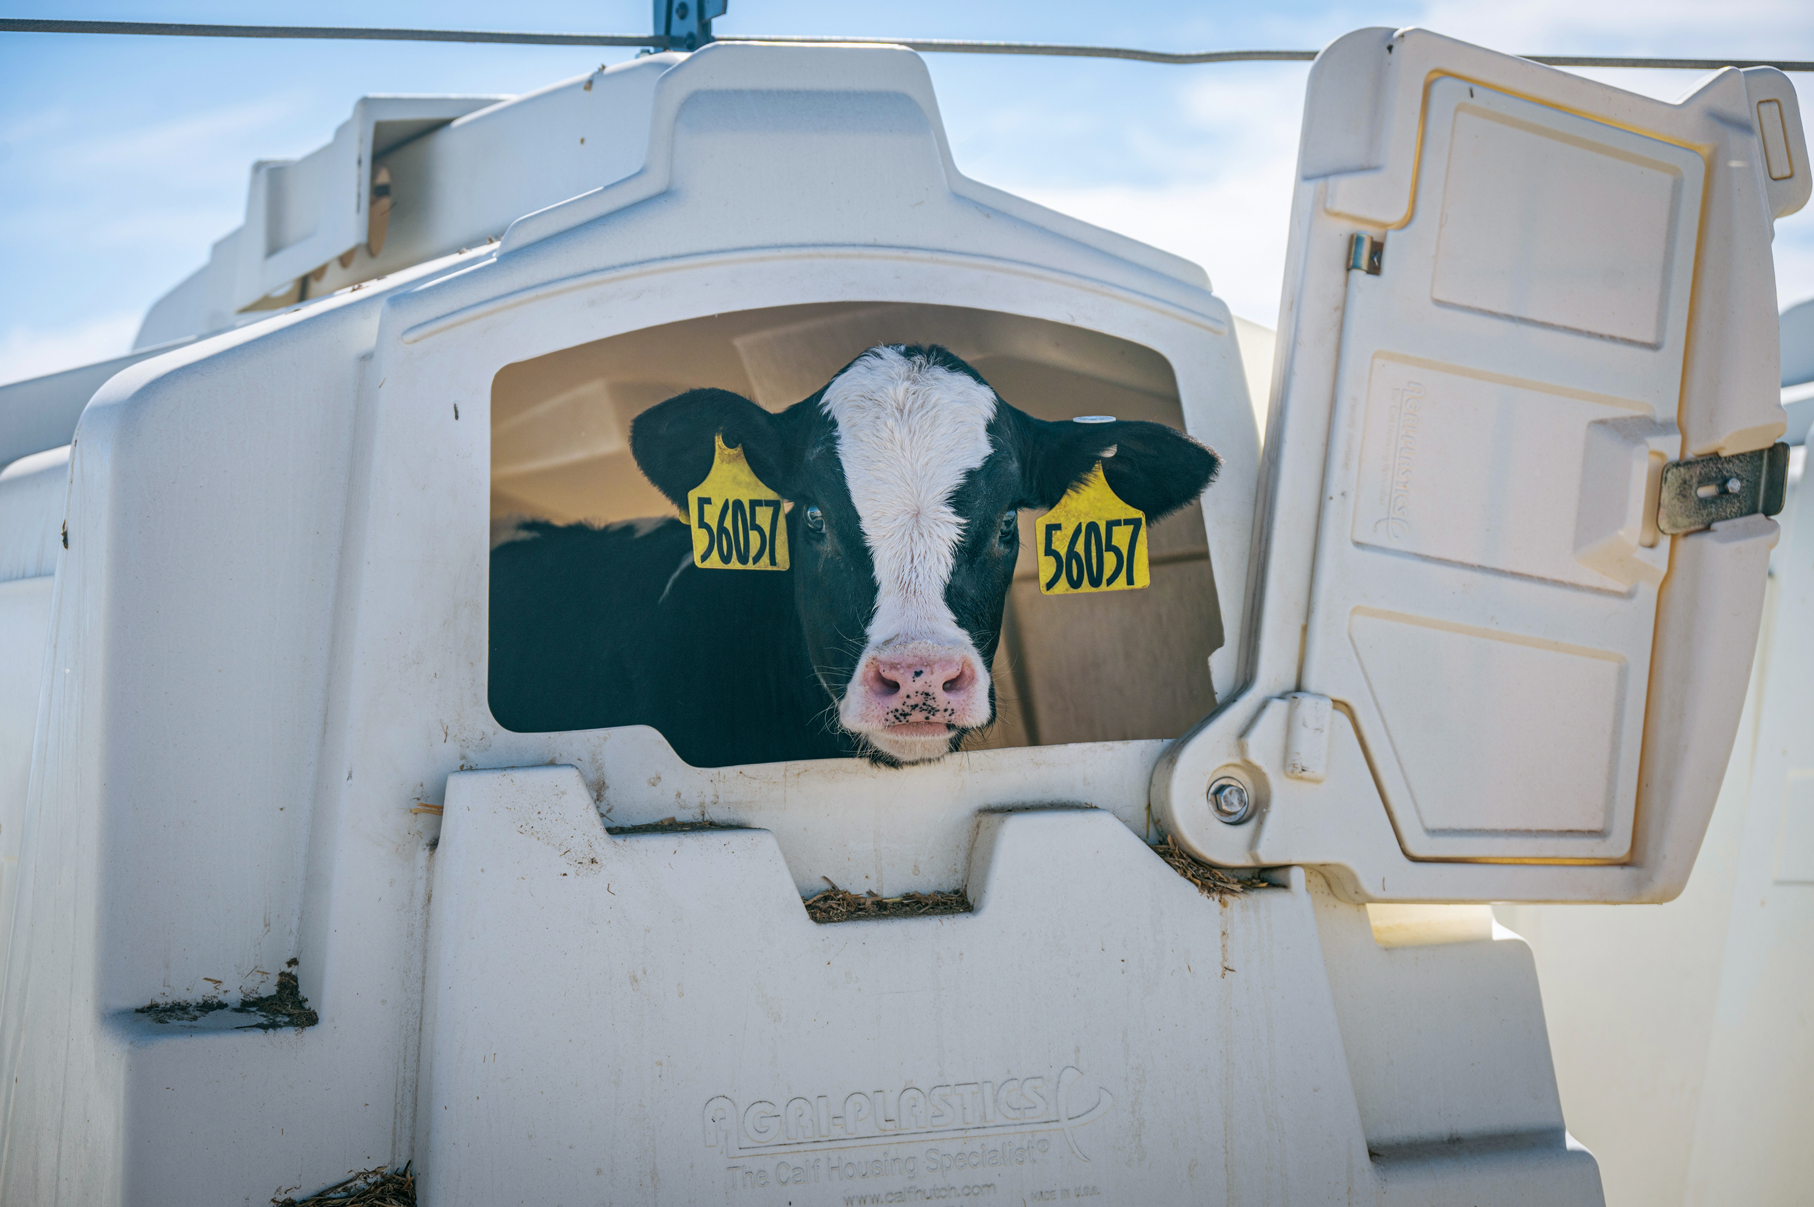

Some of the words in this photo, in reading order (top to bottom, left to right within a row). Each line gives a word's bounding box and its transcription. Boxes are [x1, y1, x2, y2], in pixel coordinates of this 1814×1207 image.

[696, 496, 782, 567] 56057
[1043, 517, 1144, 592] 56057
[702, 1076, 1047, 1149] AGRI-PLASTICS
[727, 1165, 769, 1191] The
[775, 1158, 821, 1187] Calf
[828, 1152, 917, 1180] Housing
[842, 1181, 997, 1206] www.calfhutch.com
